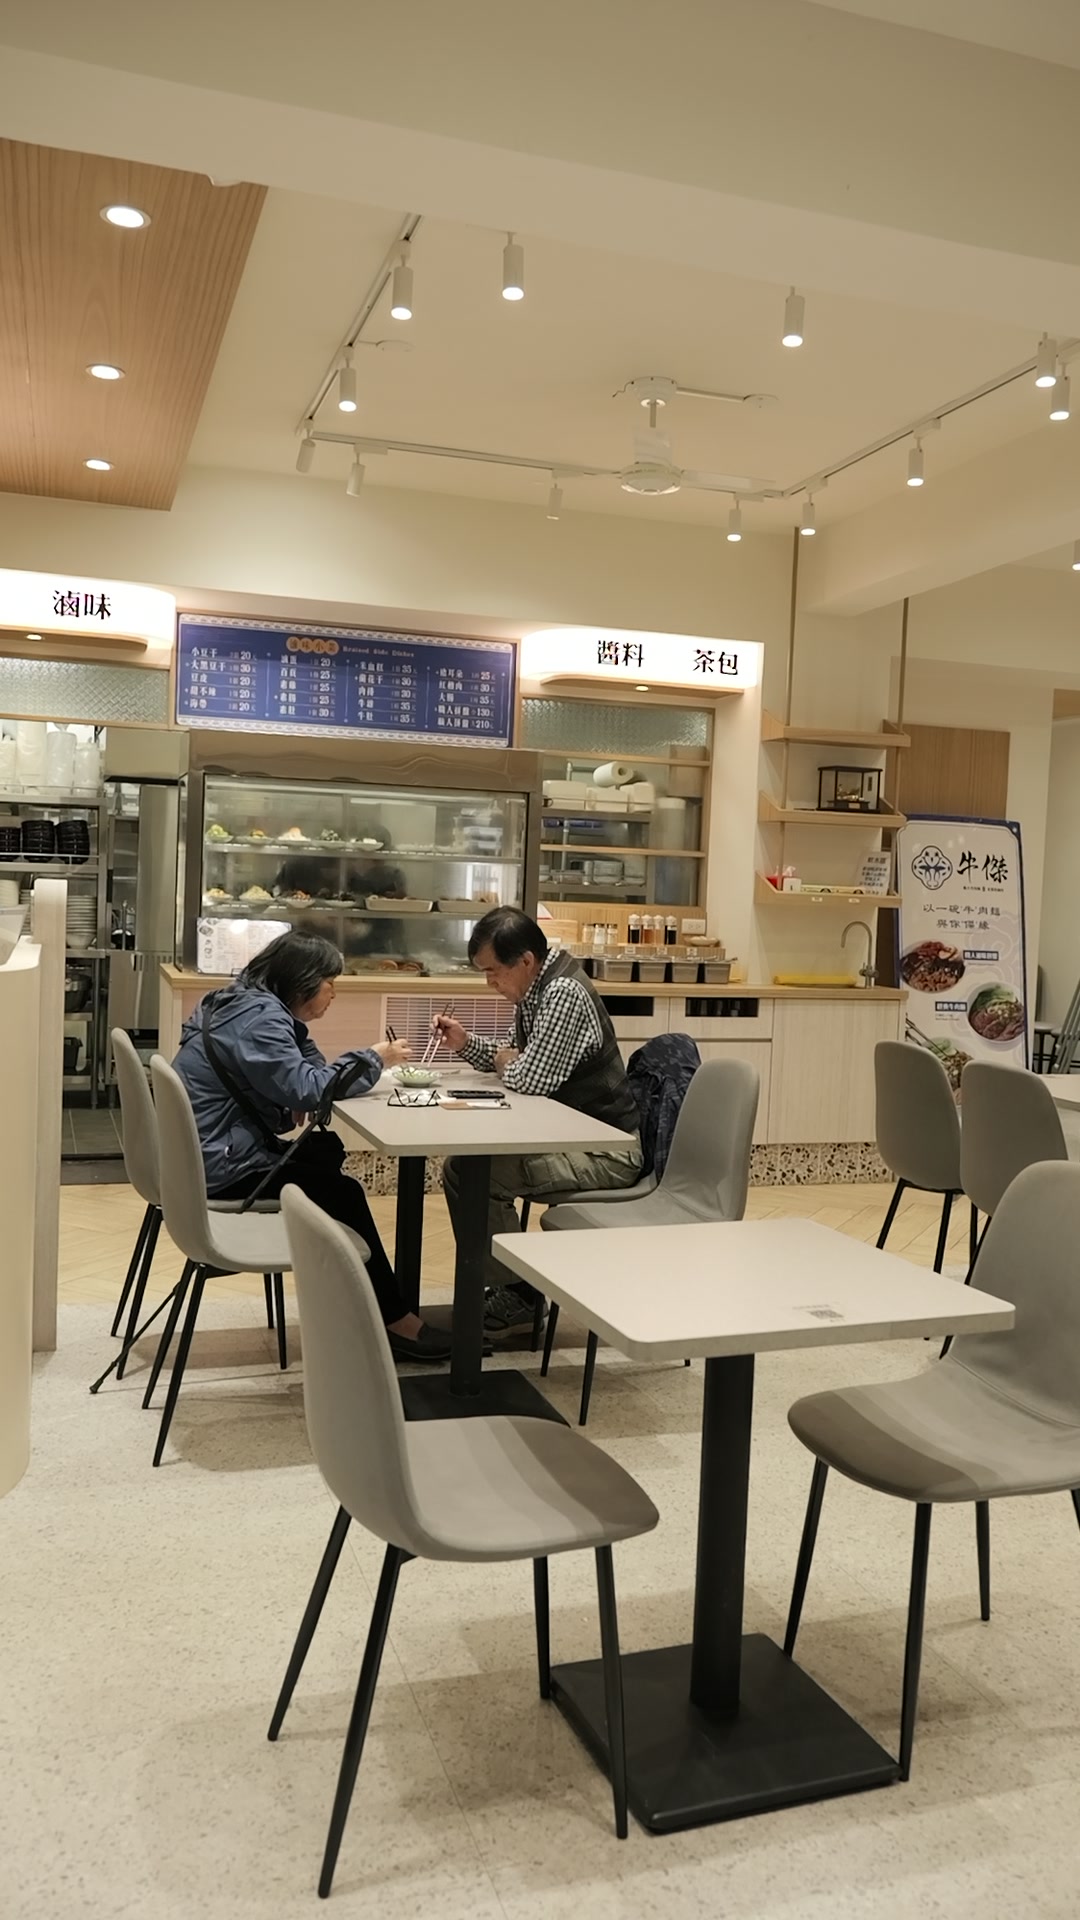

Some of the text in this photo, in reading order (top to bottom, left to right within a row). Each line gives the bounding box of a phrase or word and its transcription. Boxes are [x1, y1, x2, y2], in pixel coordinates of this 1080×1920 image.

[52, 589, 112, 620] 滷味
[191, 647, 218, 658] 小豆干
[597, 640, 739, 676] 醬料 茶包
[956, 850, 1009, 884] 牛傑
